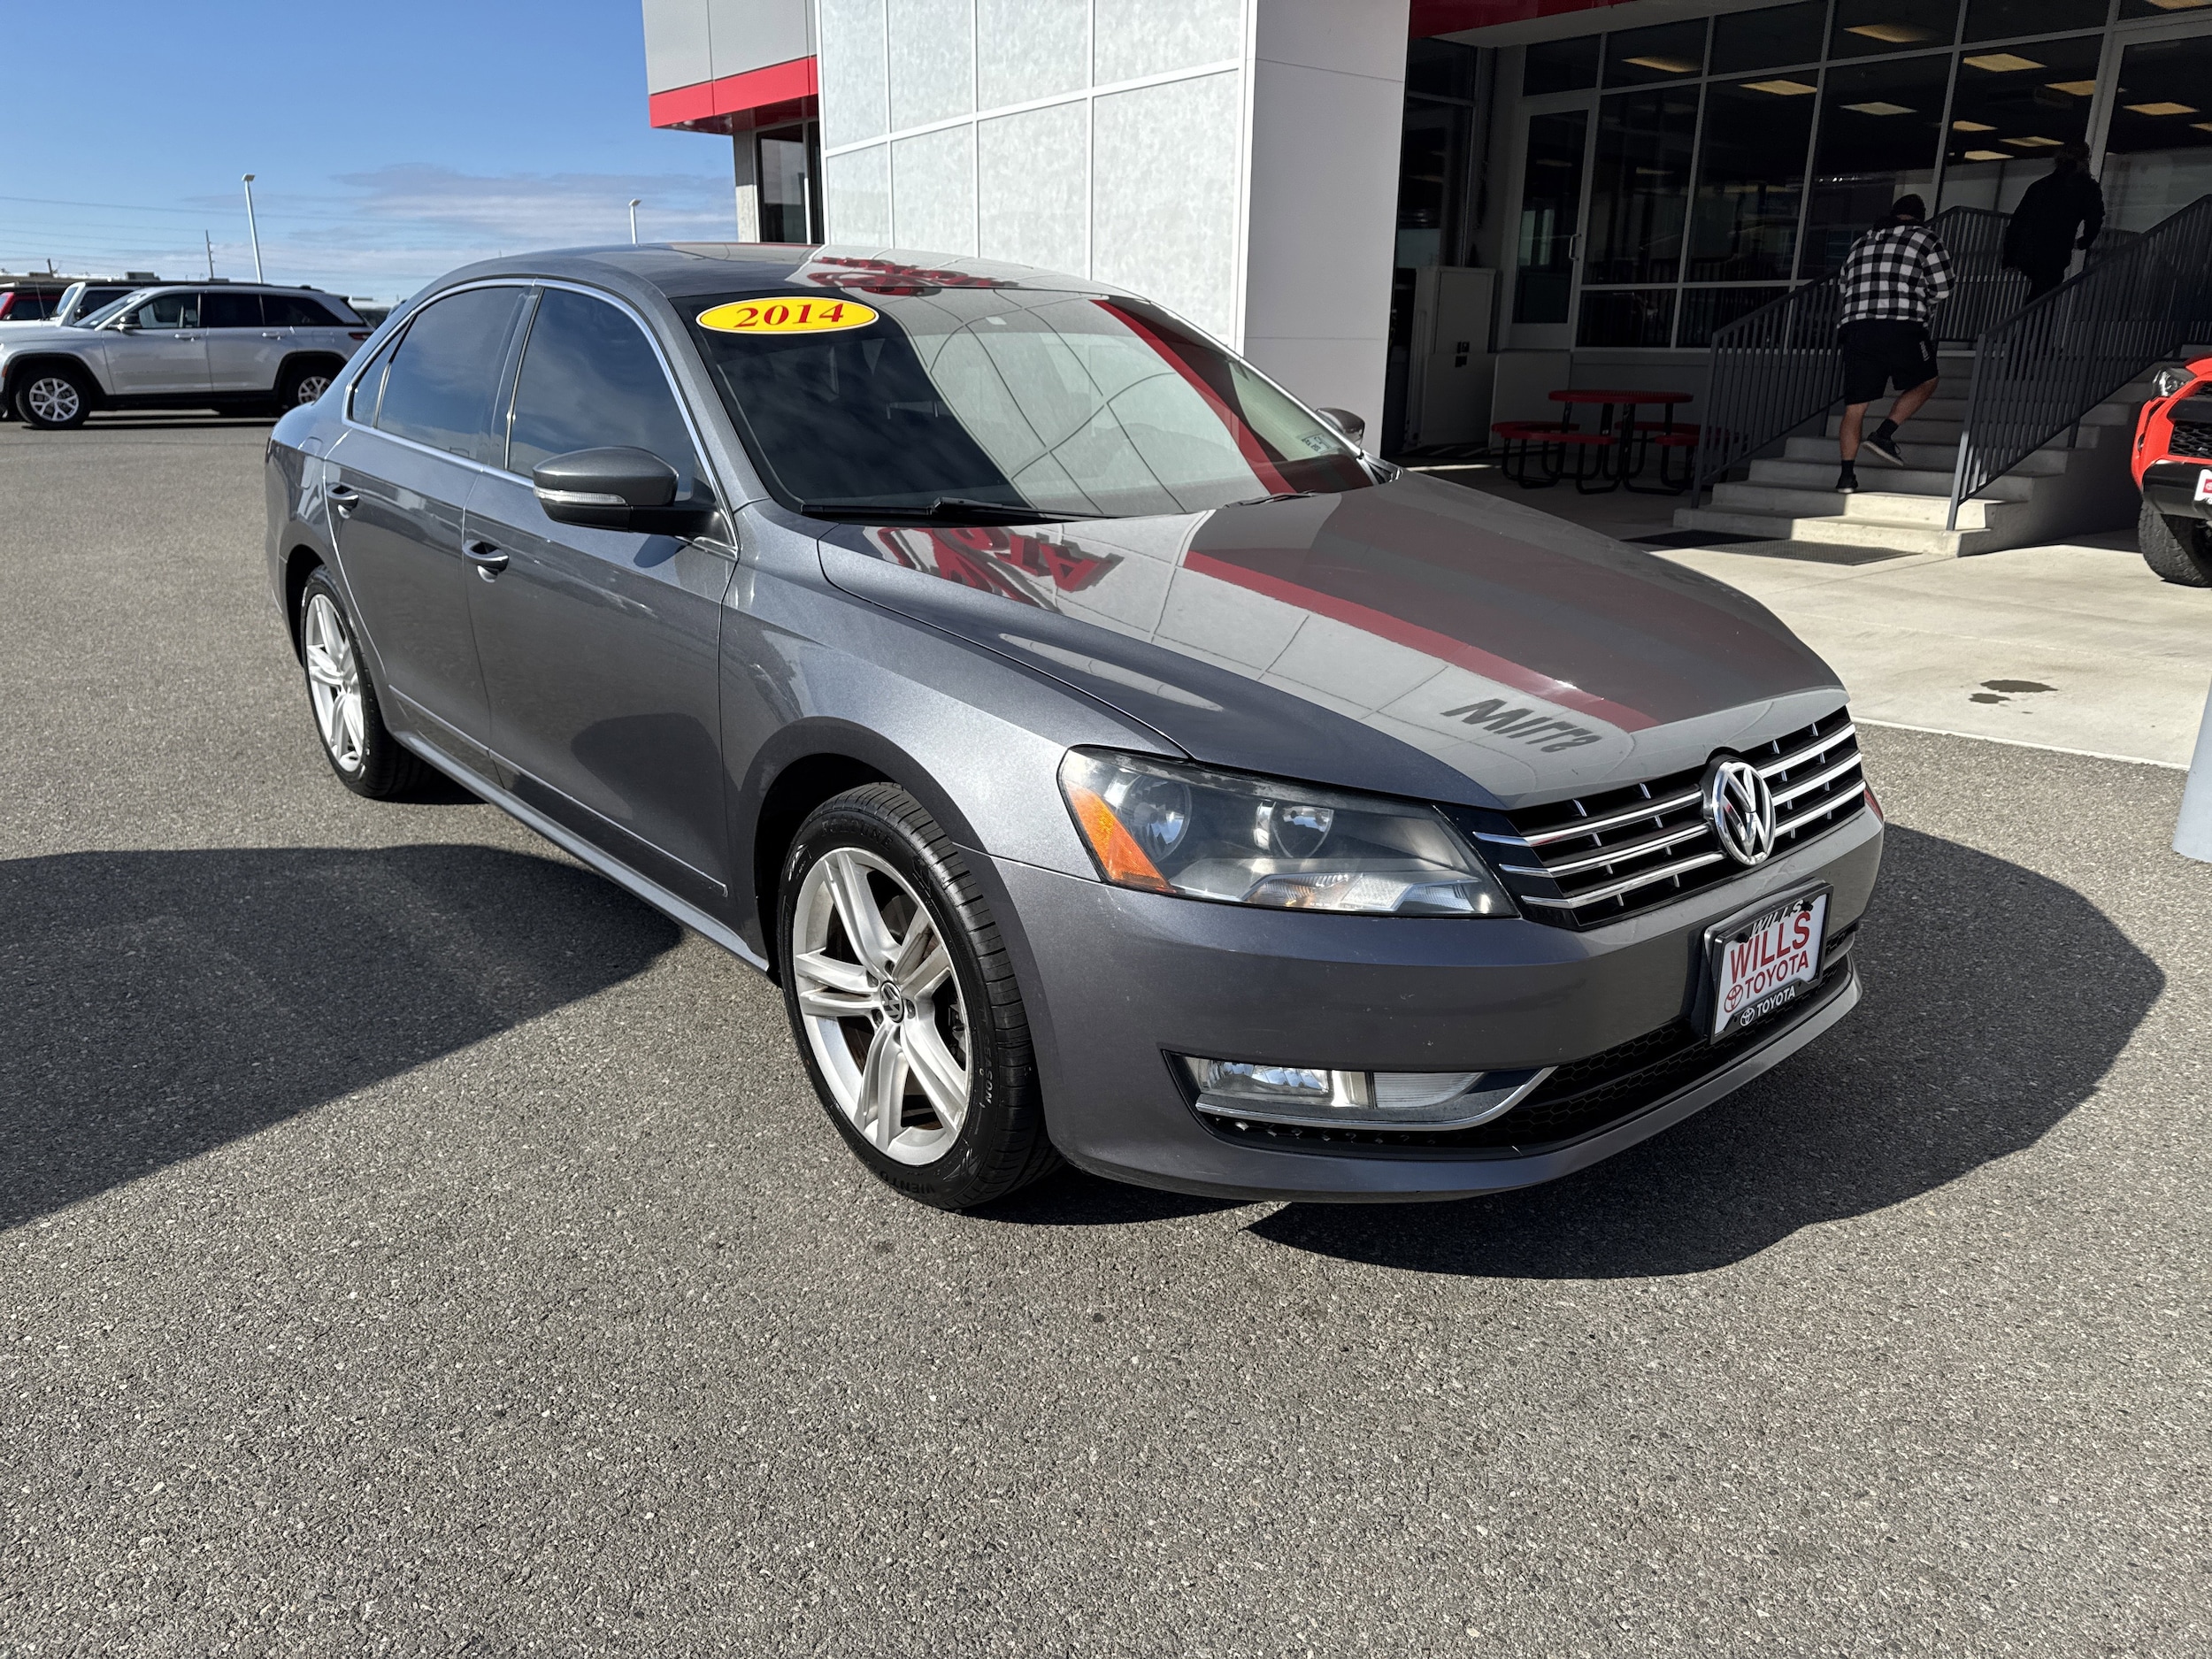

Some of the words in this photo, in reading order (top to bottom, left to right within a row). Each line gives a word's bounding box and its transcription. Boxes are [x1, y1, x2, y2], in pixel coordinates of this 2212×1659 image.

[733, 303, 844, 328] 2014
[1751, 899, 1804, 938] WILLS
[1730, 910, 1811, 985] WILLS
[1745, 950, 1809, 999] TOYOTA
[1756, 985, 1796, 1017] TOYOTA
